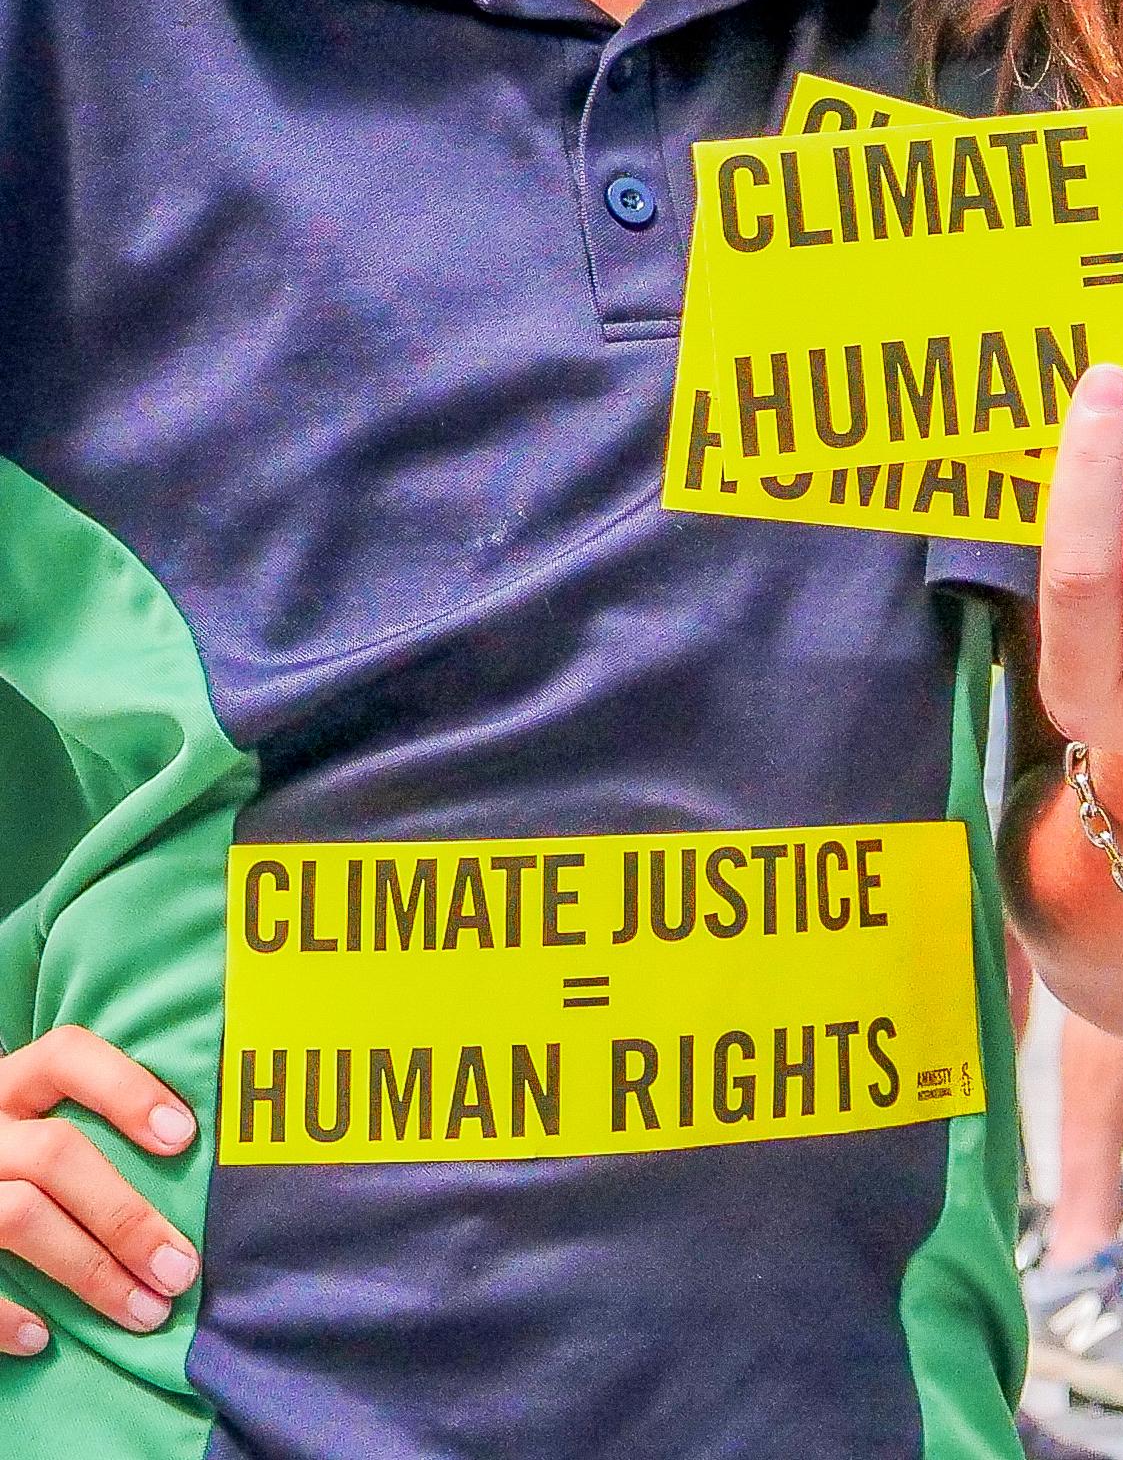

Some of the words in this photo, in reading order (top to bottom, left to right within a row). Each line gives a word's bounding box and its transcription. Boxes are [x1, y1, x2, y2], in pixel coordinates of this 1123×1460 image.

[717, 125, 1099, 252] CLIMATE
[734, 323, 1089, 458] HUMAN
[244, 854, 587, 953] CLIMATE
[612, 839, 889, 945] JUSTICE
[562, 976, 610, 1008] =
[238, 1043, 561, 1143] HUMAN
[611, 1016, 901, 1133] RIGHTS
